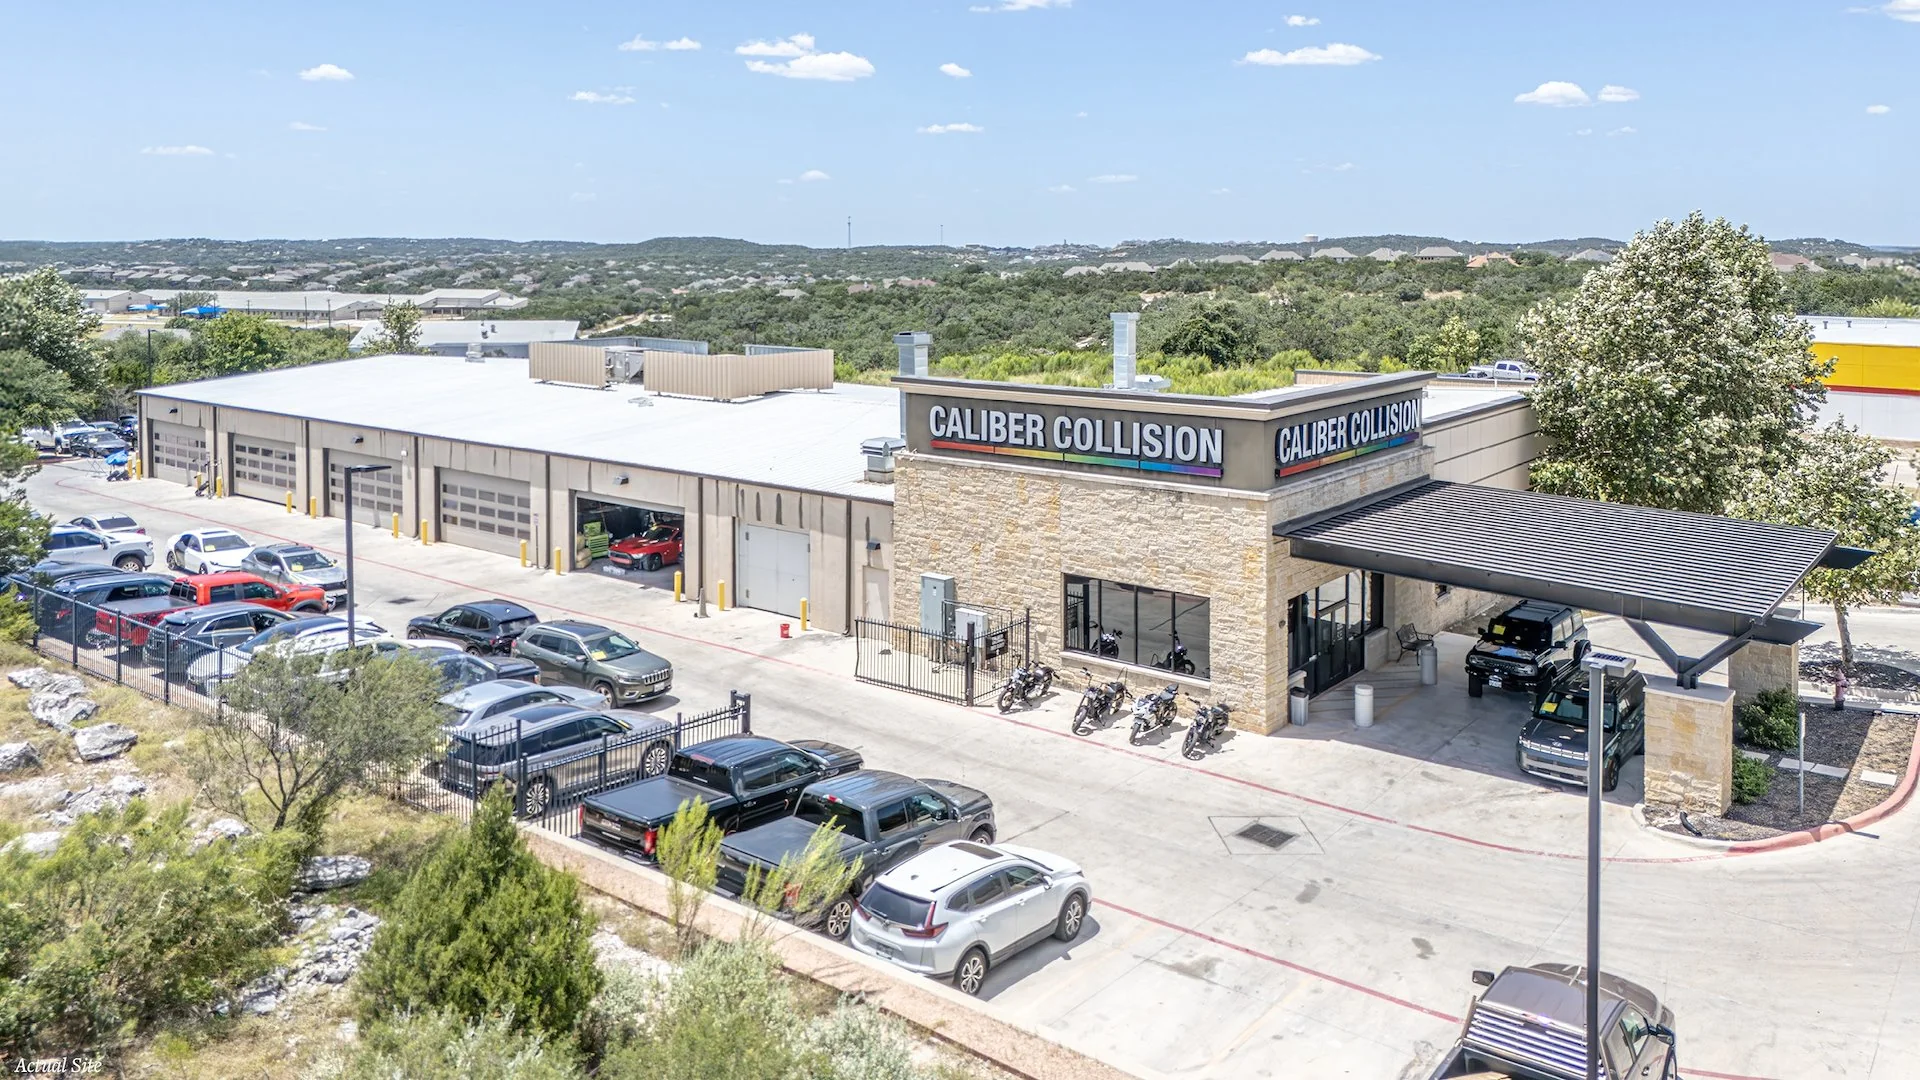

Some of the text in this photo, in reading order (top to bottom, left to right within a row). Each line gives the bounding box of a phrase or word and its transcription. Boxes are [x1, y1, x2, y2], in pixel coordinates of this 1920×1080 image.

[929, 405, 1222, 464] CALIBER COLLISION
[1279, 398, 1420, 464] CALIBER COLLISION
